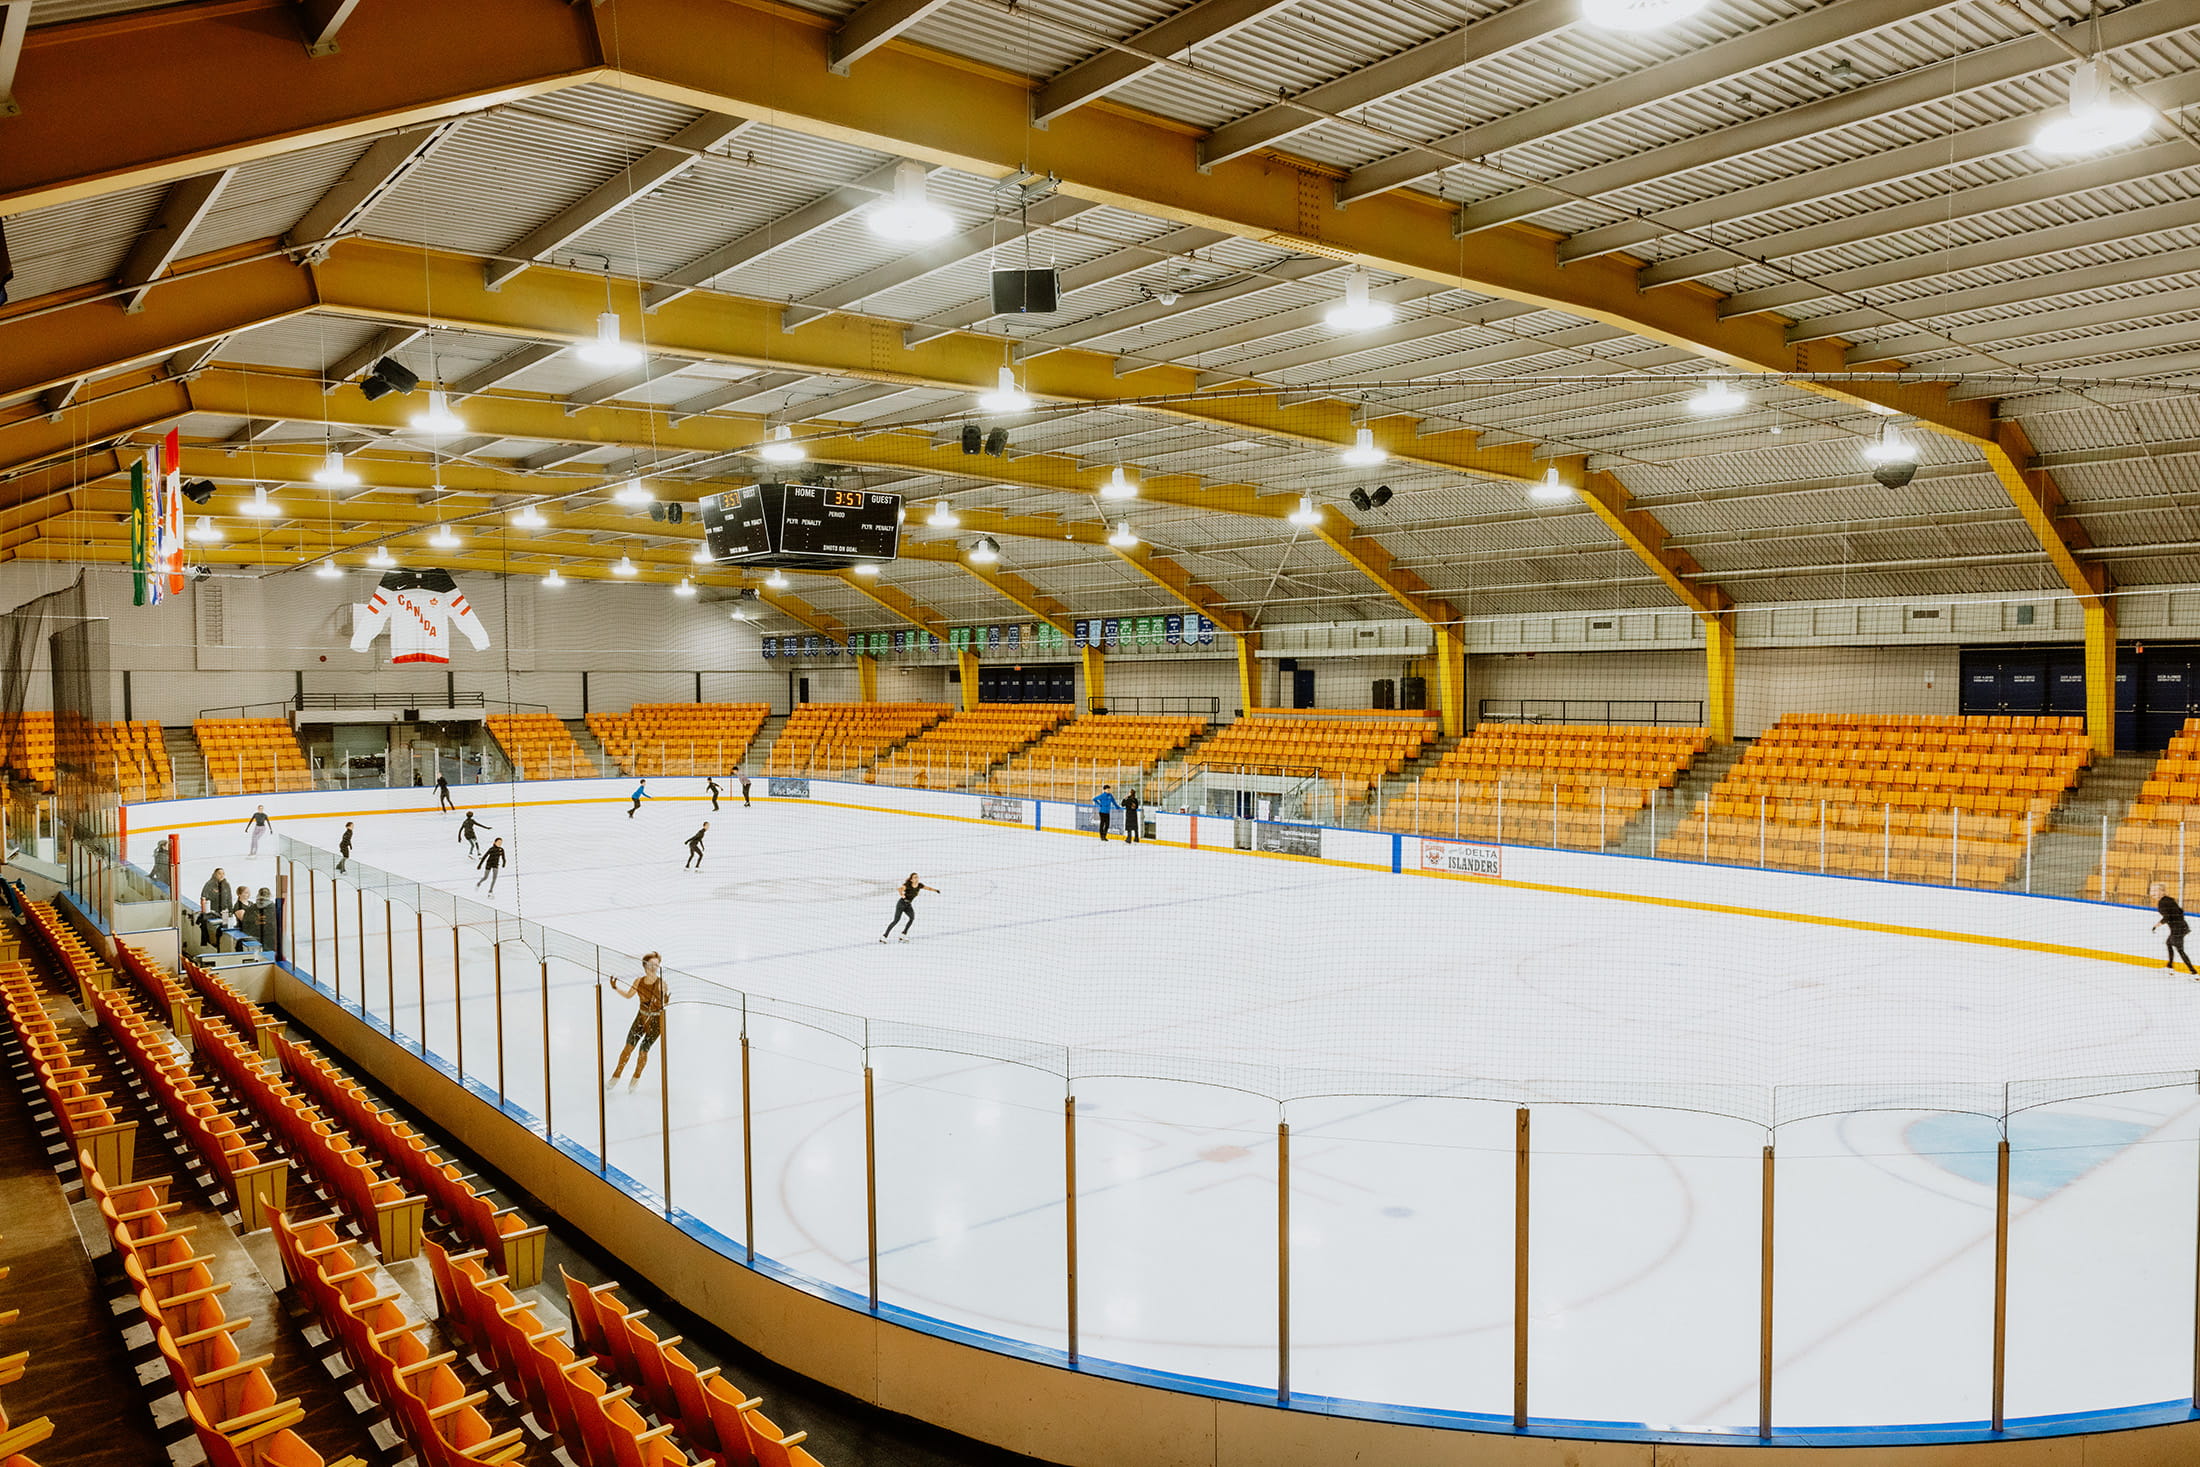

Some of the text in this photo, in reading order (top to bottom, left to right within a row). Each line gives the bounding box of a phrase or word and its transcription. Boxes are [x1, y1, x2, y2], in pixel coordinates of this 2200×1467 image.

[795, 487, 816, 498] HOME
[835, 491, 862, 506] 3:57
[871, 494, 893, 504] GUEST
[828, 511, 846, 519] PERIOD
[801, 518, 822, 526] PENALTY
[875, 524, 895, 532] PENALTY
[846, 545, 858, 553] GOAL
[397, 594, 437, 637] CANADA
[1465, 848, 1498, 859] DELTA
[1448, 856, 1498, 873] ISLANDERS
